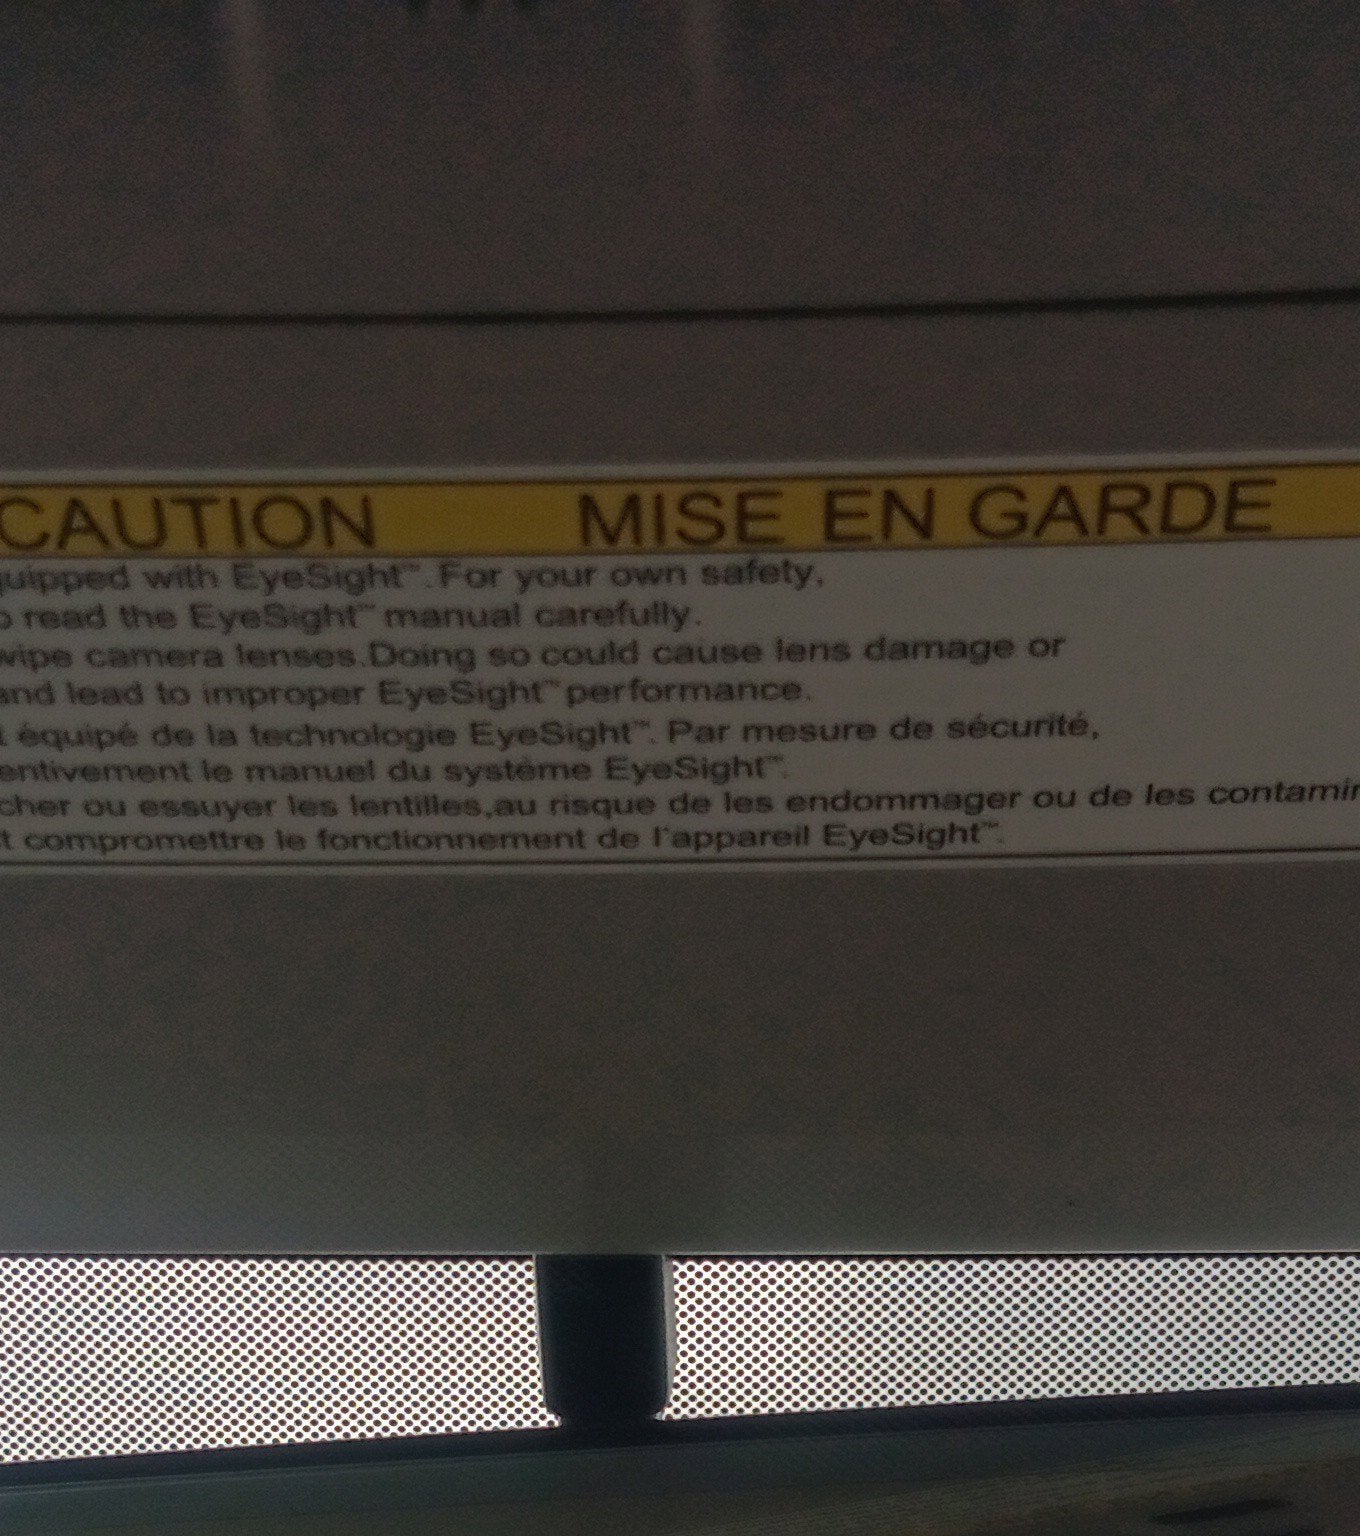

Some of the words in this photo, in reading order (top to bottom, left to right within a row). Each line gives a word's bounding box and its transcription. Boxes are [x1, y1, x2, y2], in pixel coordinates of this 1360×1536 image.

[578, 489, 783, 547] MISE
[823, 487, 935, 543] EN
[969, 478, 1276, 540] GARDE
[143, 564, 218, 589] with
[516, 568, 595, 594] your
[611, 567, 687, 587] own
[24, 603, 106, 629] read
[120, 604, 176, 629] the
[385, 602, 520, 628] manual
[86, 647, 224, 668] camera
[489, 646, 529, 666] so
[541, 640, 639, 666] could
[653, 643, 762, 664] cause
[776, 639, 850, 663] lens
[865, 636, 1014, 666] damage
[1028, 635, 1065, 659] or
[68, 681, 142, 705] lead
[158, 683, 190, 706] to
[203, 682, 363, 711] improper
[19, 721, 138, 753] équipé
[152, 722, 193, 747] de
[208, 722, 237, 747] la
[251, 721, 456, 753] technologie
[669, 719, 730, 743] Par
[743, 719, 876, 742] mesure
[889, 715, 934, 741] de
[203, 759, 233, 782] le
[246, 758, 376, 782] manuel
[388, 759, 431, 782] du
[444, 756, 592, 787] système
[84, 798, 126, 817] ou
[139, 797, 277, 823] essuyer
[289, 793, 337, 817] les
[549, 794, 655, 820] risque
[669, 791, 711, 815] de
[724, 791, 772, 814] les
[786, 788, 1022, 817] endommager
[1032, 789, 1076, 808] ou
[1090, 784, 1133, 808] de
[1146, 782, 1194, 805] les
[25, 828, 265, 855] compromettre
[276, 828, 306, 850] le
[317, 826, 584, 851] fonctionnement
[598, 826, 639, 848] de
